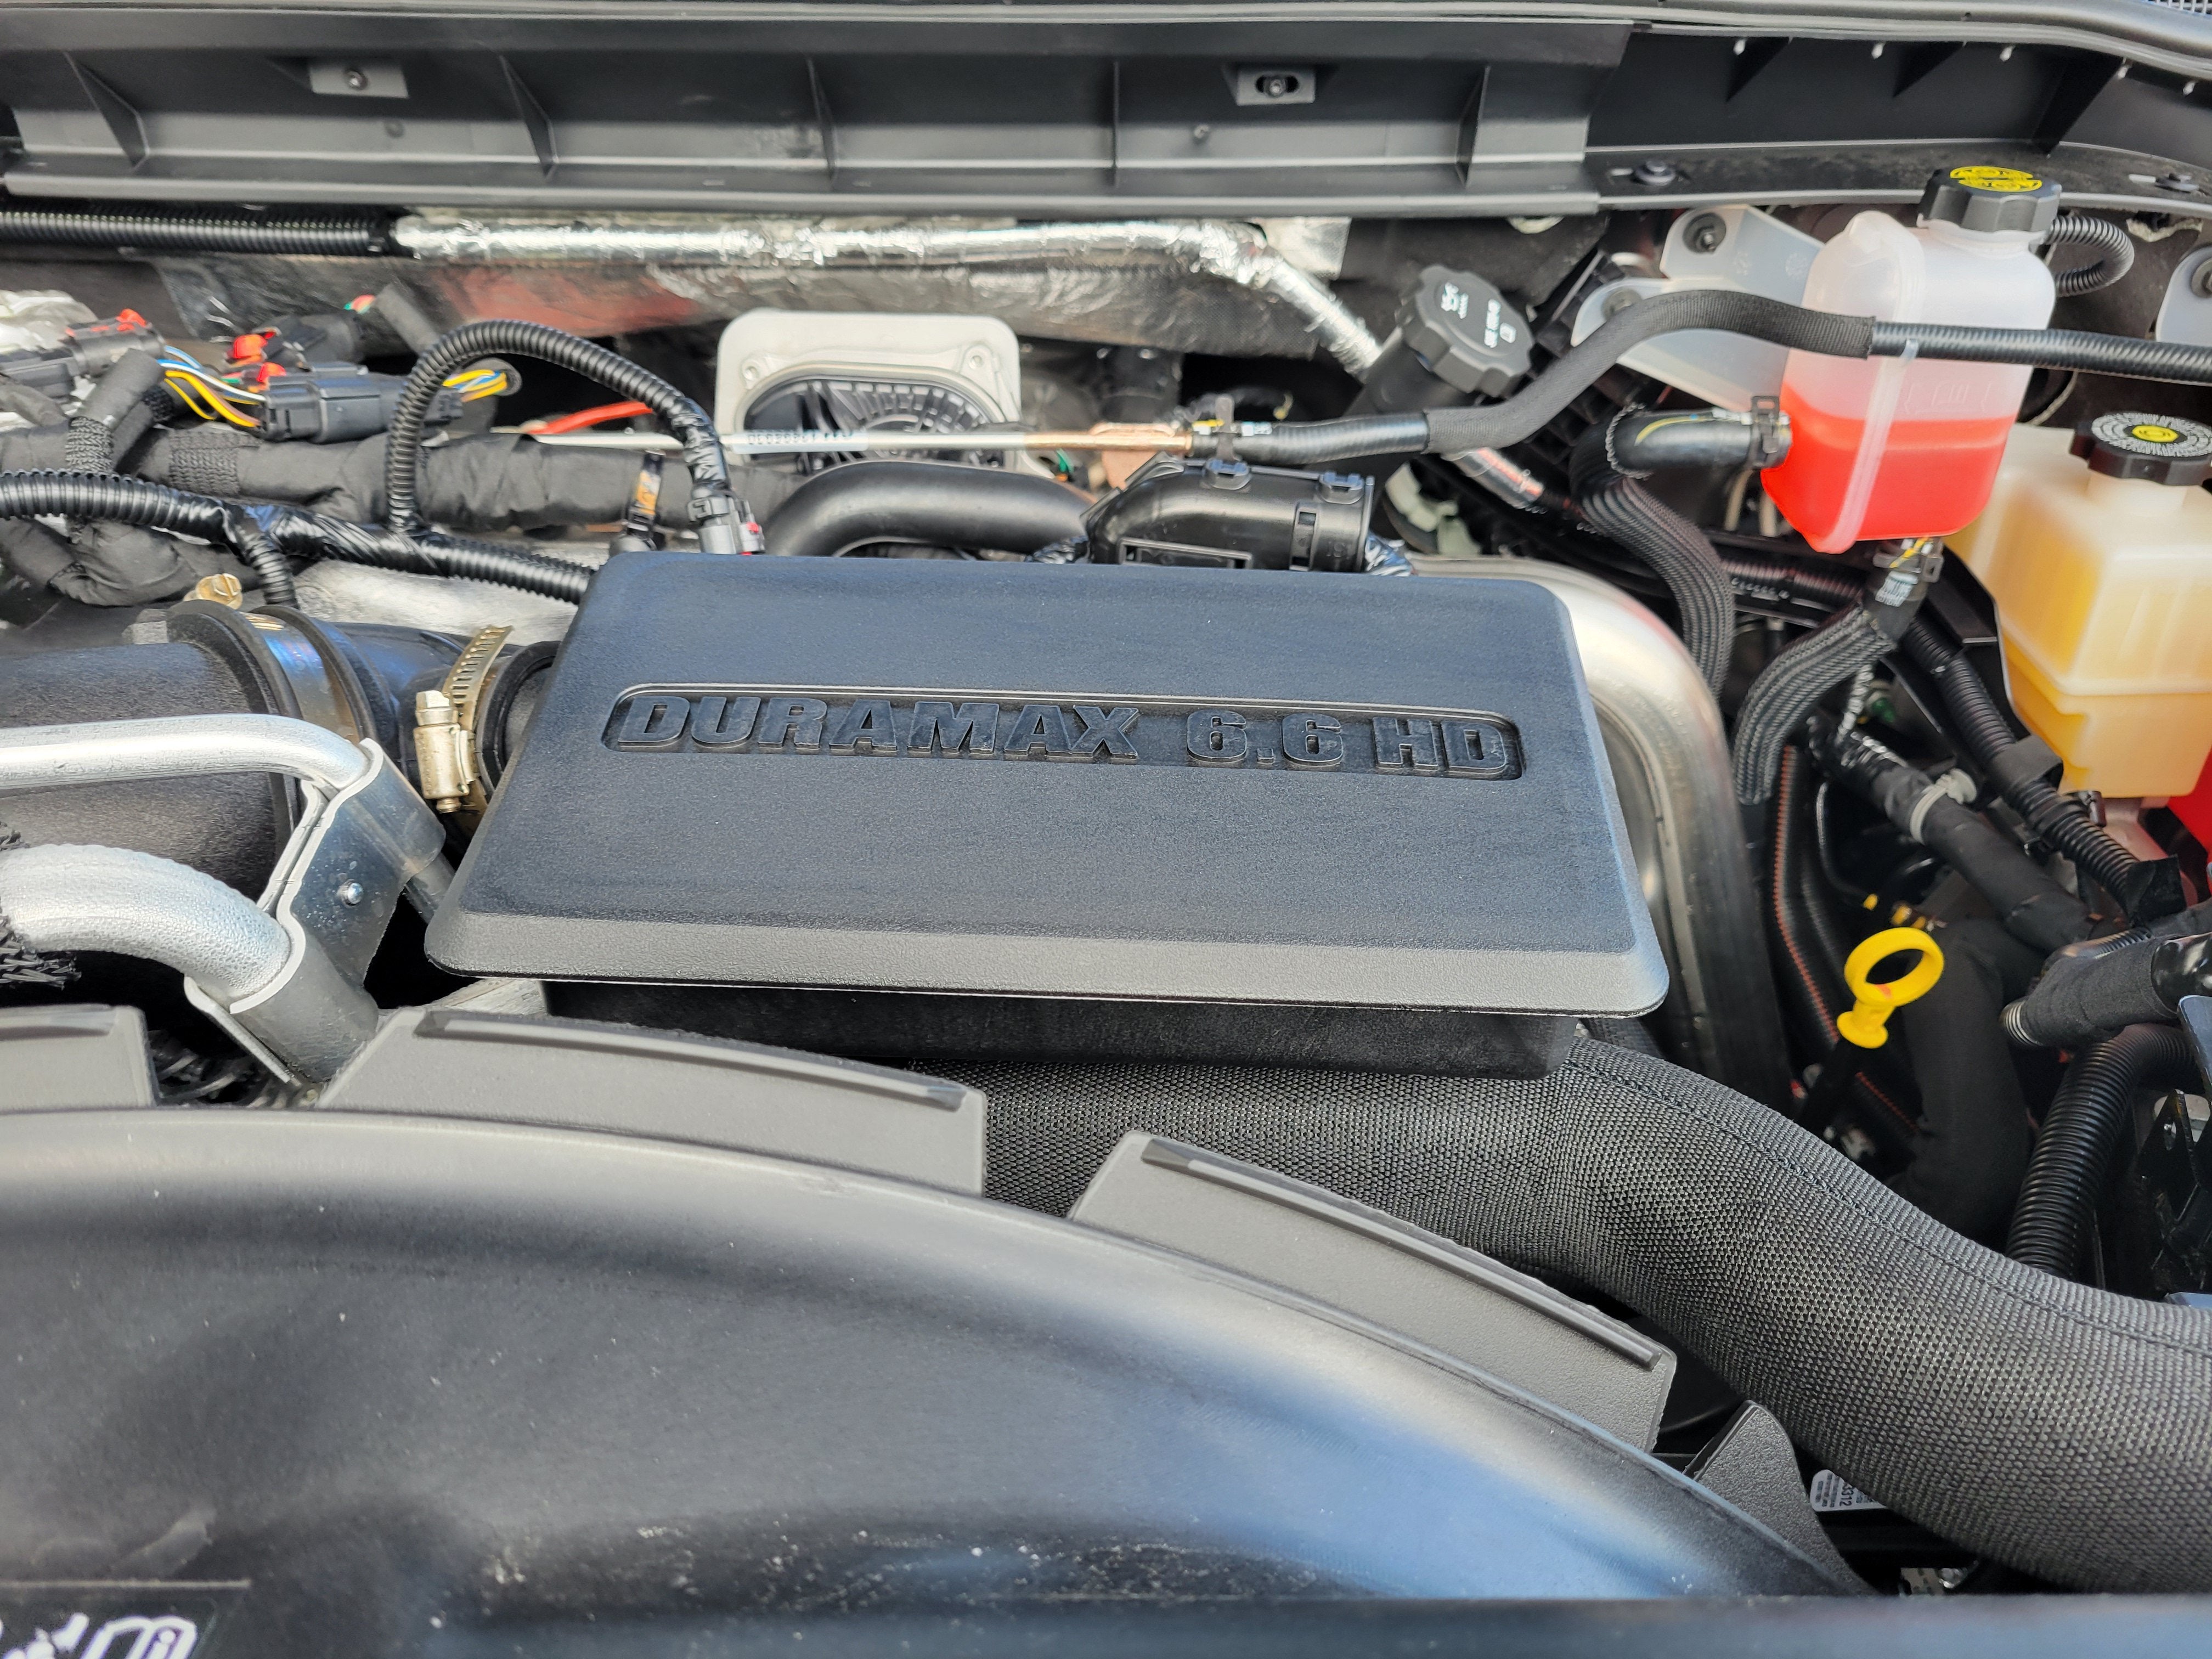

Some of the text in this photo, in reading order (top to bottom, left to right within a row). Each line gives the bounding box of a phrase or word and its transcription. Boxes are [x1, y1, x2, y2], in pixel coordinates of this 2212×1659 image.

[618, 696, 1508, 775] DURAMAX 6.6 HD
